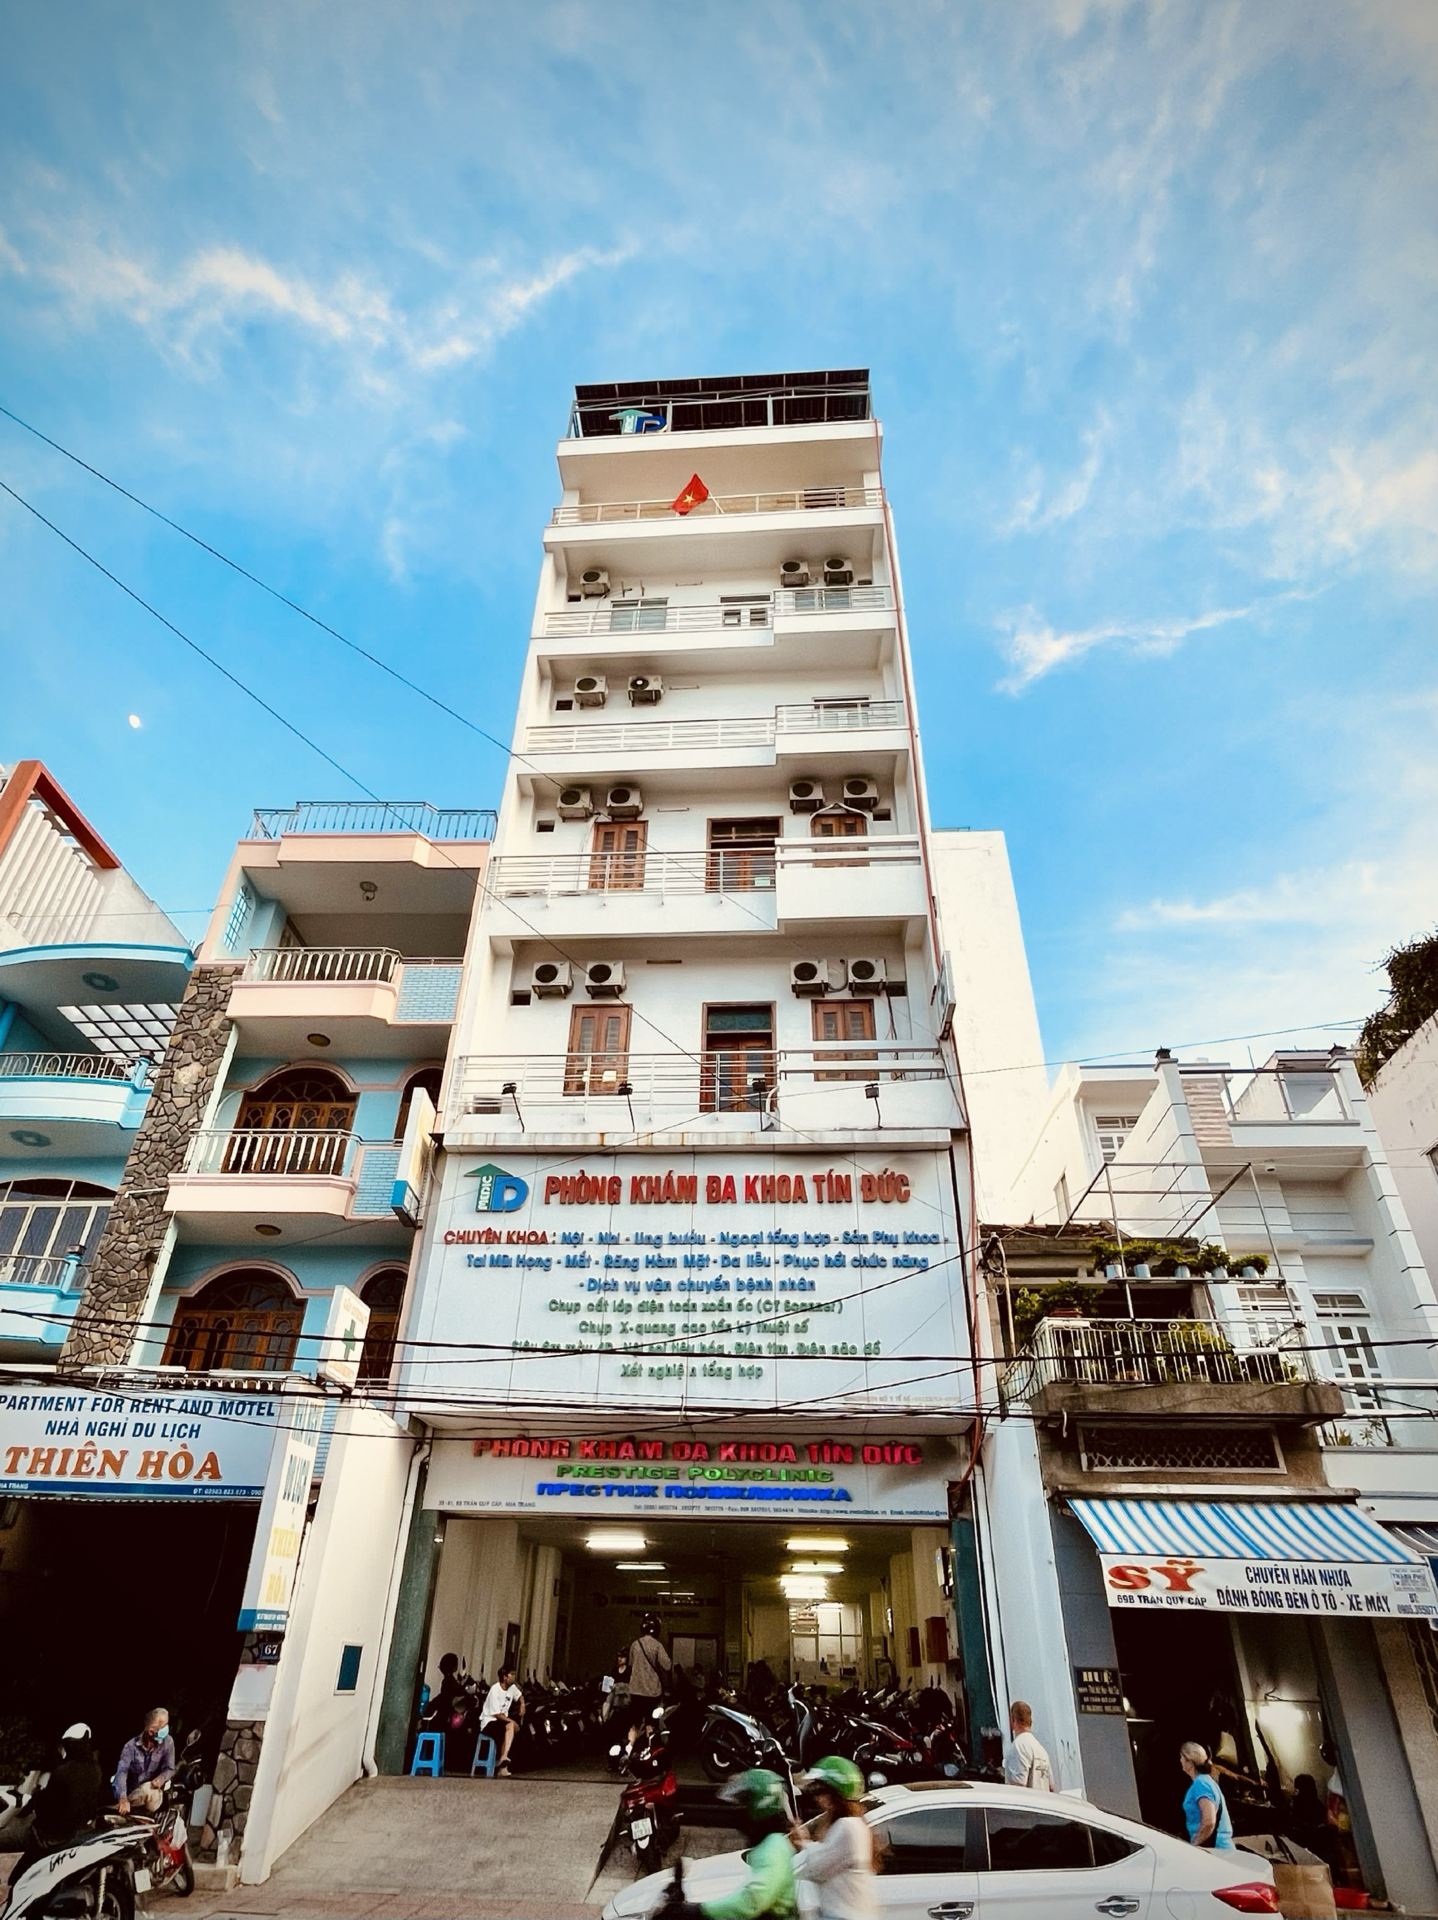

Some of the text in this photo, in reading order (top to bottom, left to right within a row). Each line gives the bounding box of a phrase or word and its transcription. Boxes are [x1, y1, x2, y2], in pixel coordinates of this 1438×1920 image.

[478, 1175, 493, 1210] MEDIC
[545, 1168, 911, 1204] PHÒNG KHÁM ĐA KHOA TÍN ĐỨC
[443, 1227, 502, 1245] CHUYÊN
[719, 1231, 764, 1248] Ngoại
[516, 1254, 552, 1271] Họng
[604, 1254, 639, 1271] Răng
[645, 1254, 677, 1269] Hàm
[783, 1254, 820, 1271] Phục
[588, 1275, 816, 1295] Dịch vụ vận chuyển bệnh nhân
[549, 1299, 581, 1315] Chụp
[587, 1297, 609, 1312] cắt
[613, 1299, 633, 1315] lớp
[638, 1300, 665, 1314] điện
[669, 1299, 698, 1312] toán
[737, 1298, 753, 1312] ốc
[579, 1320, 612, 1336] Chụp
[620, 1321, 676, 1337] X-quang
[682, 1322, 707, 1334] cao
[794, 1318, 811, 1334] số
[621, 1361, 643, 1377] Xét
[702, 1361, 733, 1380] tổng
[738, 1364, 763, 1380] hợp
[91, 1396, 124, 1413] FOR
[131, 1398, 174, 1415] RENT
[178, 1399, 214, 1416] AND
[218, 1400, 276, 1417] MOTEL
[45, 1417, 202, 1442] NHÀ NGHỈ DU LỊCH
[578, 1435, 665, 1460] KHÁM
[719, 1441, 798, 1462] KHOA
[806, 1439, 855, 1464] TÍN
[4, 1440, 222, 1481] THIÊN HÒA
[557, 1464, 834, 1482] PRESTIGE POLYCLINIC
[536, 1482, 659, 1498] ПРЕСТИЖ
[1108, 1559, 1206, 1592] SỸ
[1245, 1564, 1353, 1592] CHUYÊN HÀN NHỰA
[1117, 1594, 1135, 1605] 69B
[1250, 1586, 1284, 1609] BÓNG
[1284, 1588, 1310, 1610] ĐÈN
[1311, 1588, 1320, 1610] Ô
[1322, 1589, 1338, 1611] TÔ
[1347, 1594, 1363, 1612] XE
[1364, 1592, 1392, 1613] MÁY
[264, 1643, 279, 1656] 67
